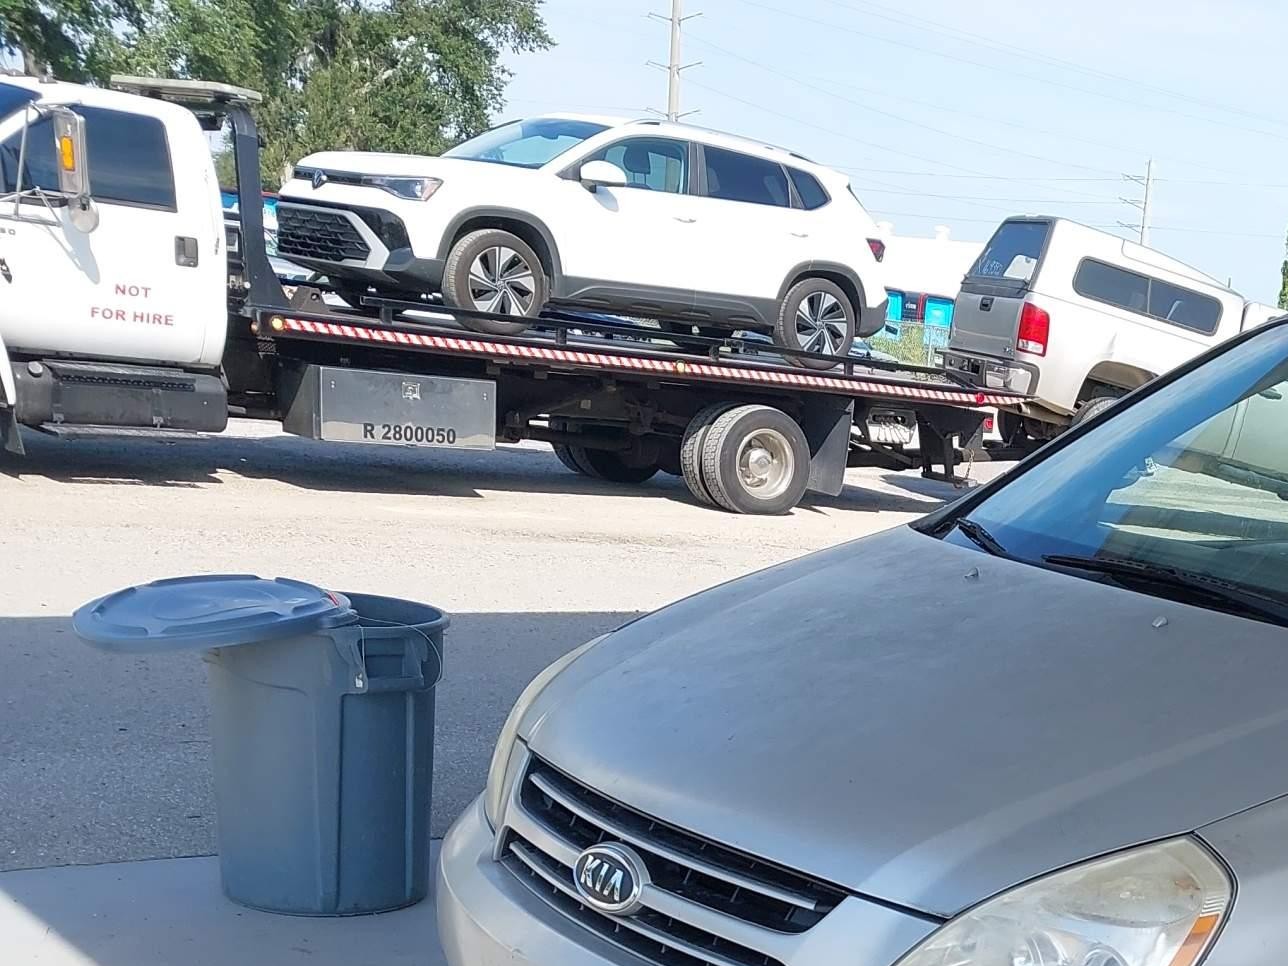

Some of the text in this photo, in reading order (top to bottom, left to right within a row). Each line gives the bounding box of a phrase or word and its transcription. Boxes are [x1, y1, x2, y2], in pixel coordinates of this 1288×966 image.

[115, 283, 152, 298] NOT
[91, 306, 175, 326] FOR HIRE
[363, 422, 456, 444] R 2800050
[580, 854, 624, 902] KIA
